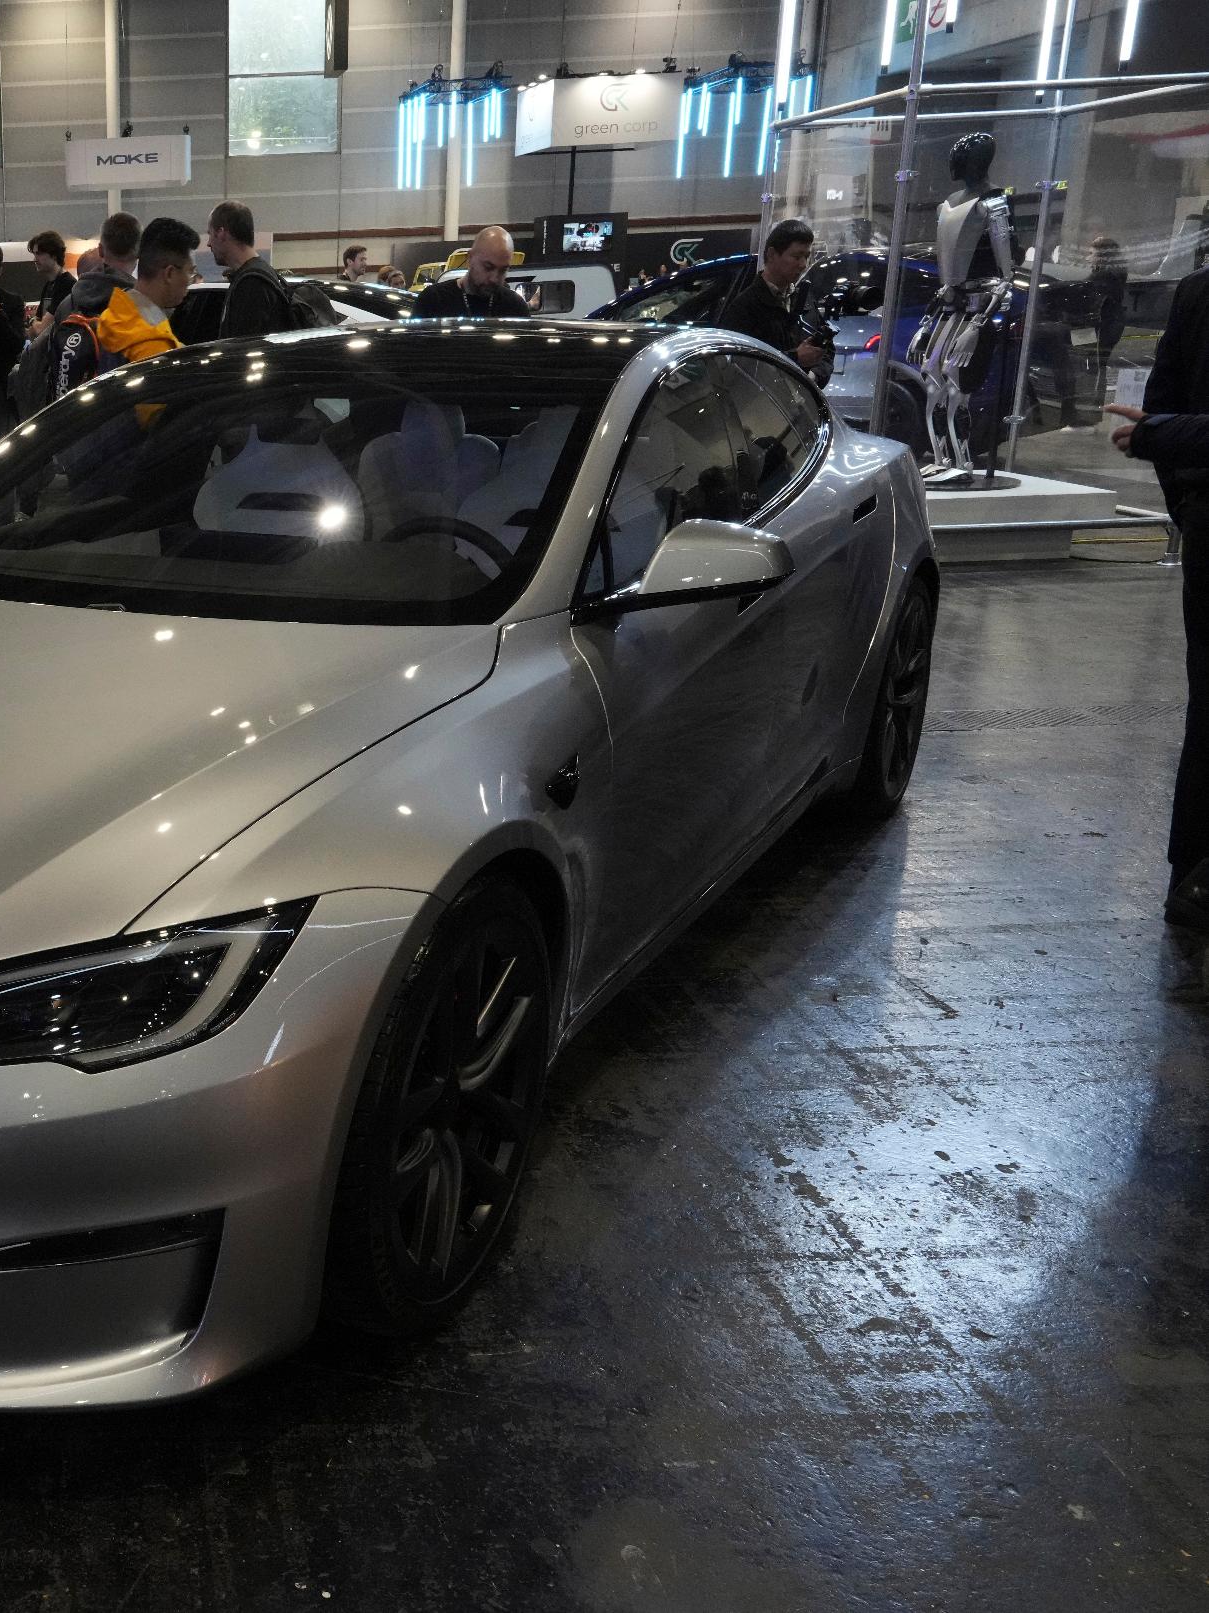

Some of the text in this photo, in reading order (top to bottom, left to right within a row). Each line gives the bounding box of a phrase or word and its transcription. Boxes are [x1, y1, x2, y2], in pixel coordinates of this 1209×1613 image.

[574, 119, 659, 138] green corp
[96, 152, 159, 166] MOKE
